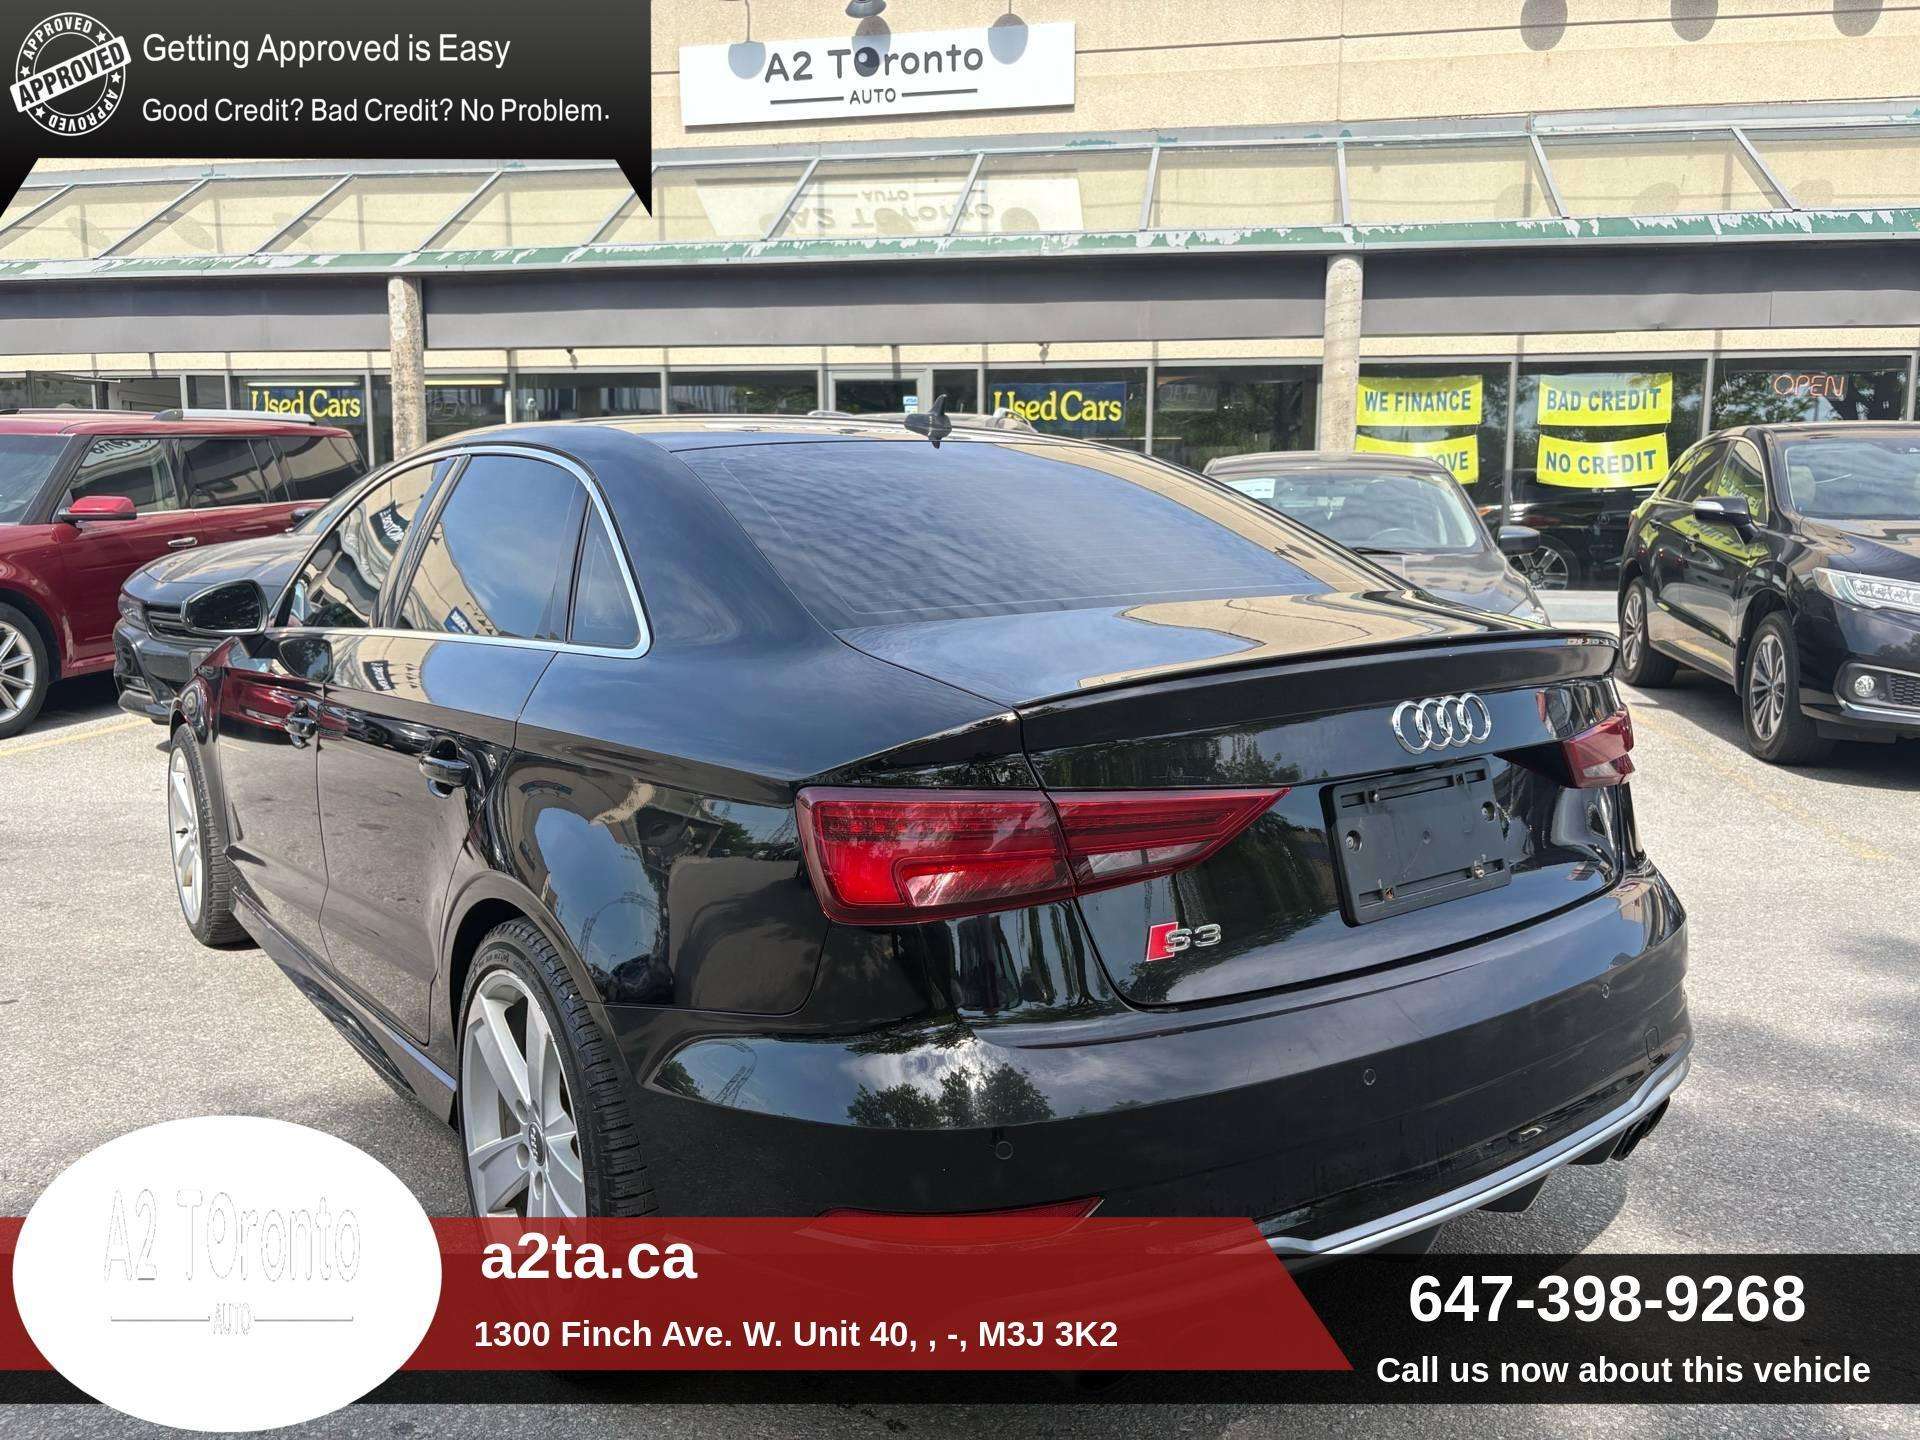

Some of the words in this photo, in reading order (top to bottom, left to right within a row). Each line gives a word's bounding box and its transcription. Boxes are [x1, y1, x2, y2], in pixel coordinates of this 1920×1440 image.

[765, 51, 813, 83] A2
[850, 88, 896, 105] AUTO
[1774, 374, 1845, 397] OPEN
[251, 390, 304, 416] Used
[310, 389, 361, 418] Cars
[994, 391, 1057, 420] Used
[1060, 390, 1123, 423] Cars
[1365, 391, 1389, 412] WE
[1394, 390, 1471, 412] FINANCE
[1546, 388, 1582, 412] BAD
[1588, 387, 1661, 412] CREDIT
[1546, 450, 1571, 473] NO
[1577, 449, 1657, 475] CREDIT
[1165, 923, 1222, 953] S3
